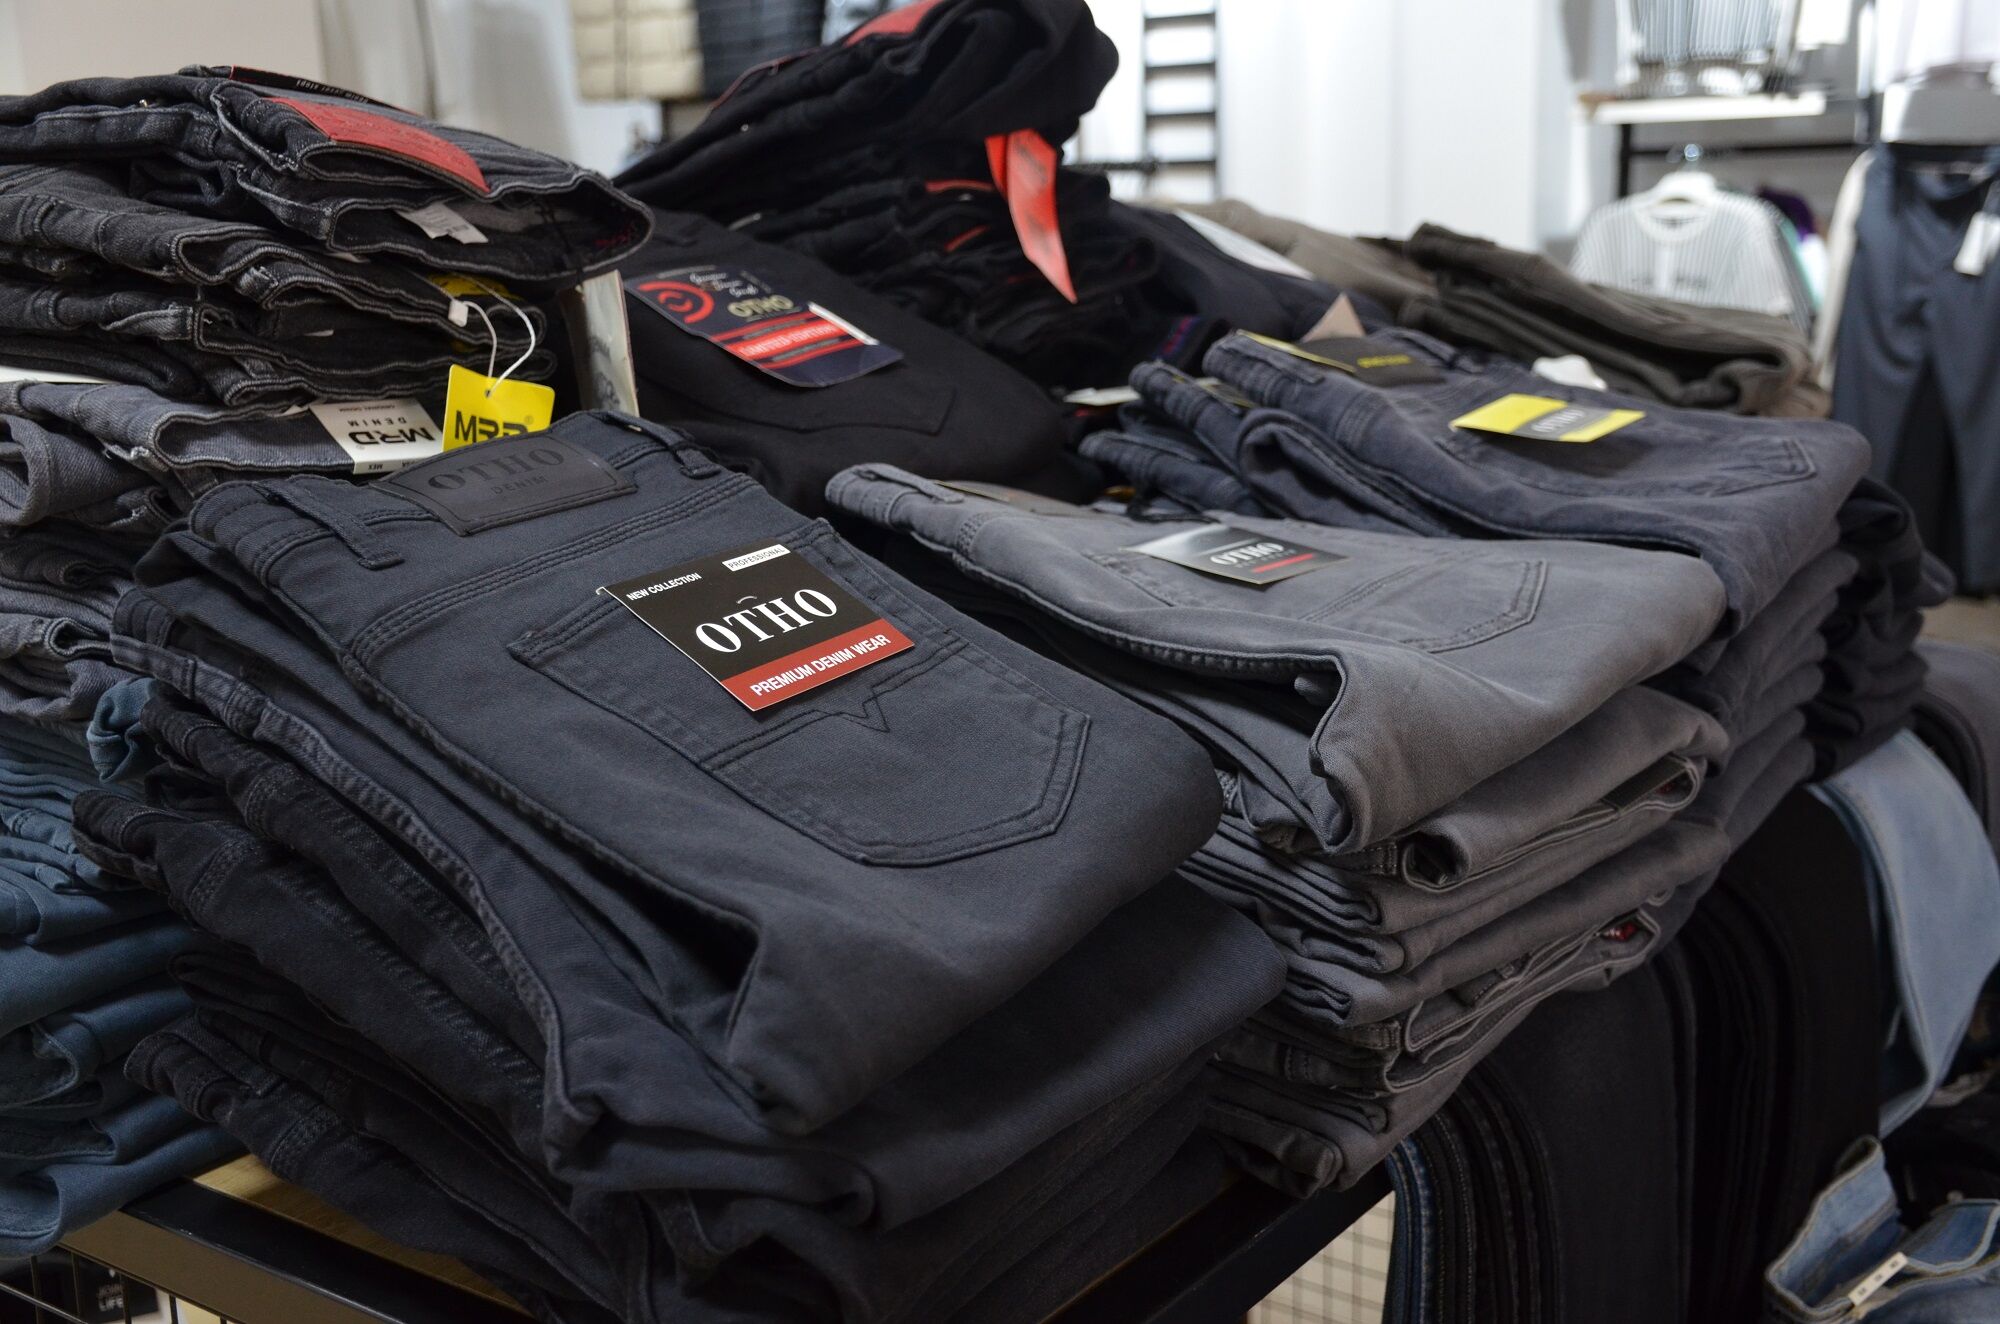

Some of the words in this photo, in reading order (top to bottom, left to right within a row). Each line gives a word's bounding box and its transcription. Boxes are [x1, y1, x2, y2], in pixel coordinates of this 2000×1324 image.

[348, 417, 407, 427] DENIM
[348, 427, 436, 445] MRD
[428, 449, 564, 490] OTHO
[490, 475, 549, 495] DENIM
[727, 546, 787, 569] PROFESSIONAL
[626, 588, 648, 601] NEW
[647, 572, 702, 595] COLLECTION
[695, 589, 838, 653] OTHO
[750, 664, 813, 696] PREMIUM
[811, 648, 854, 673] DENIM
[852, 634, 891, 656] WEAR
